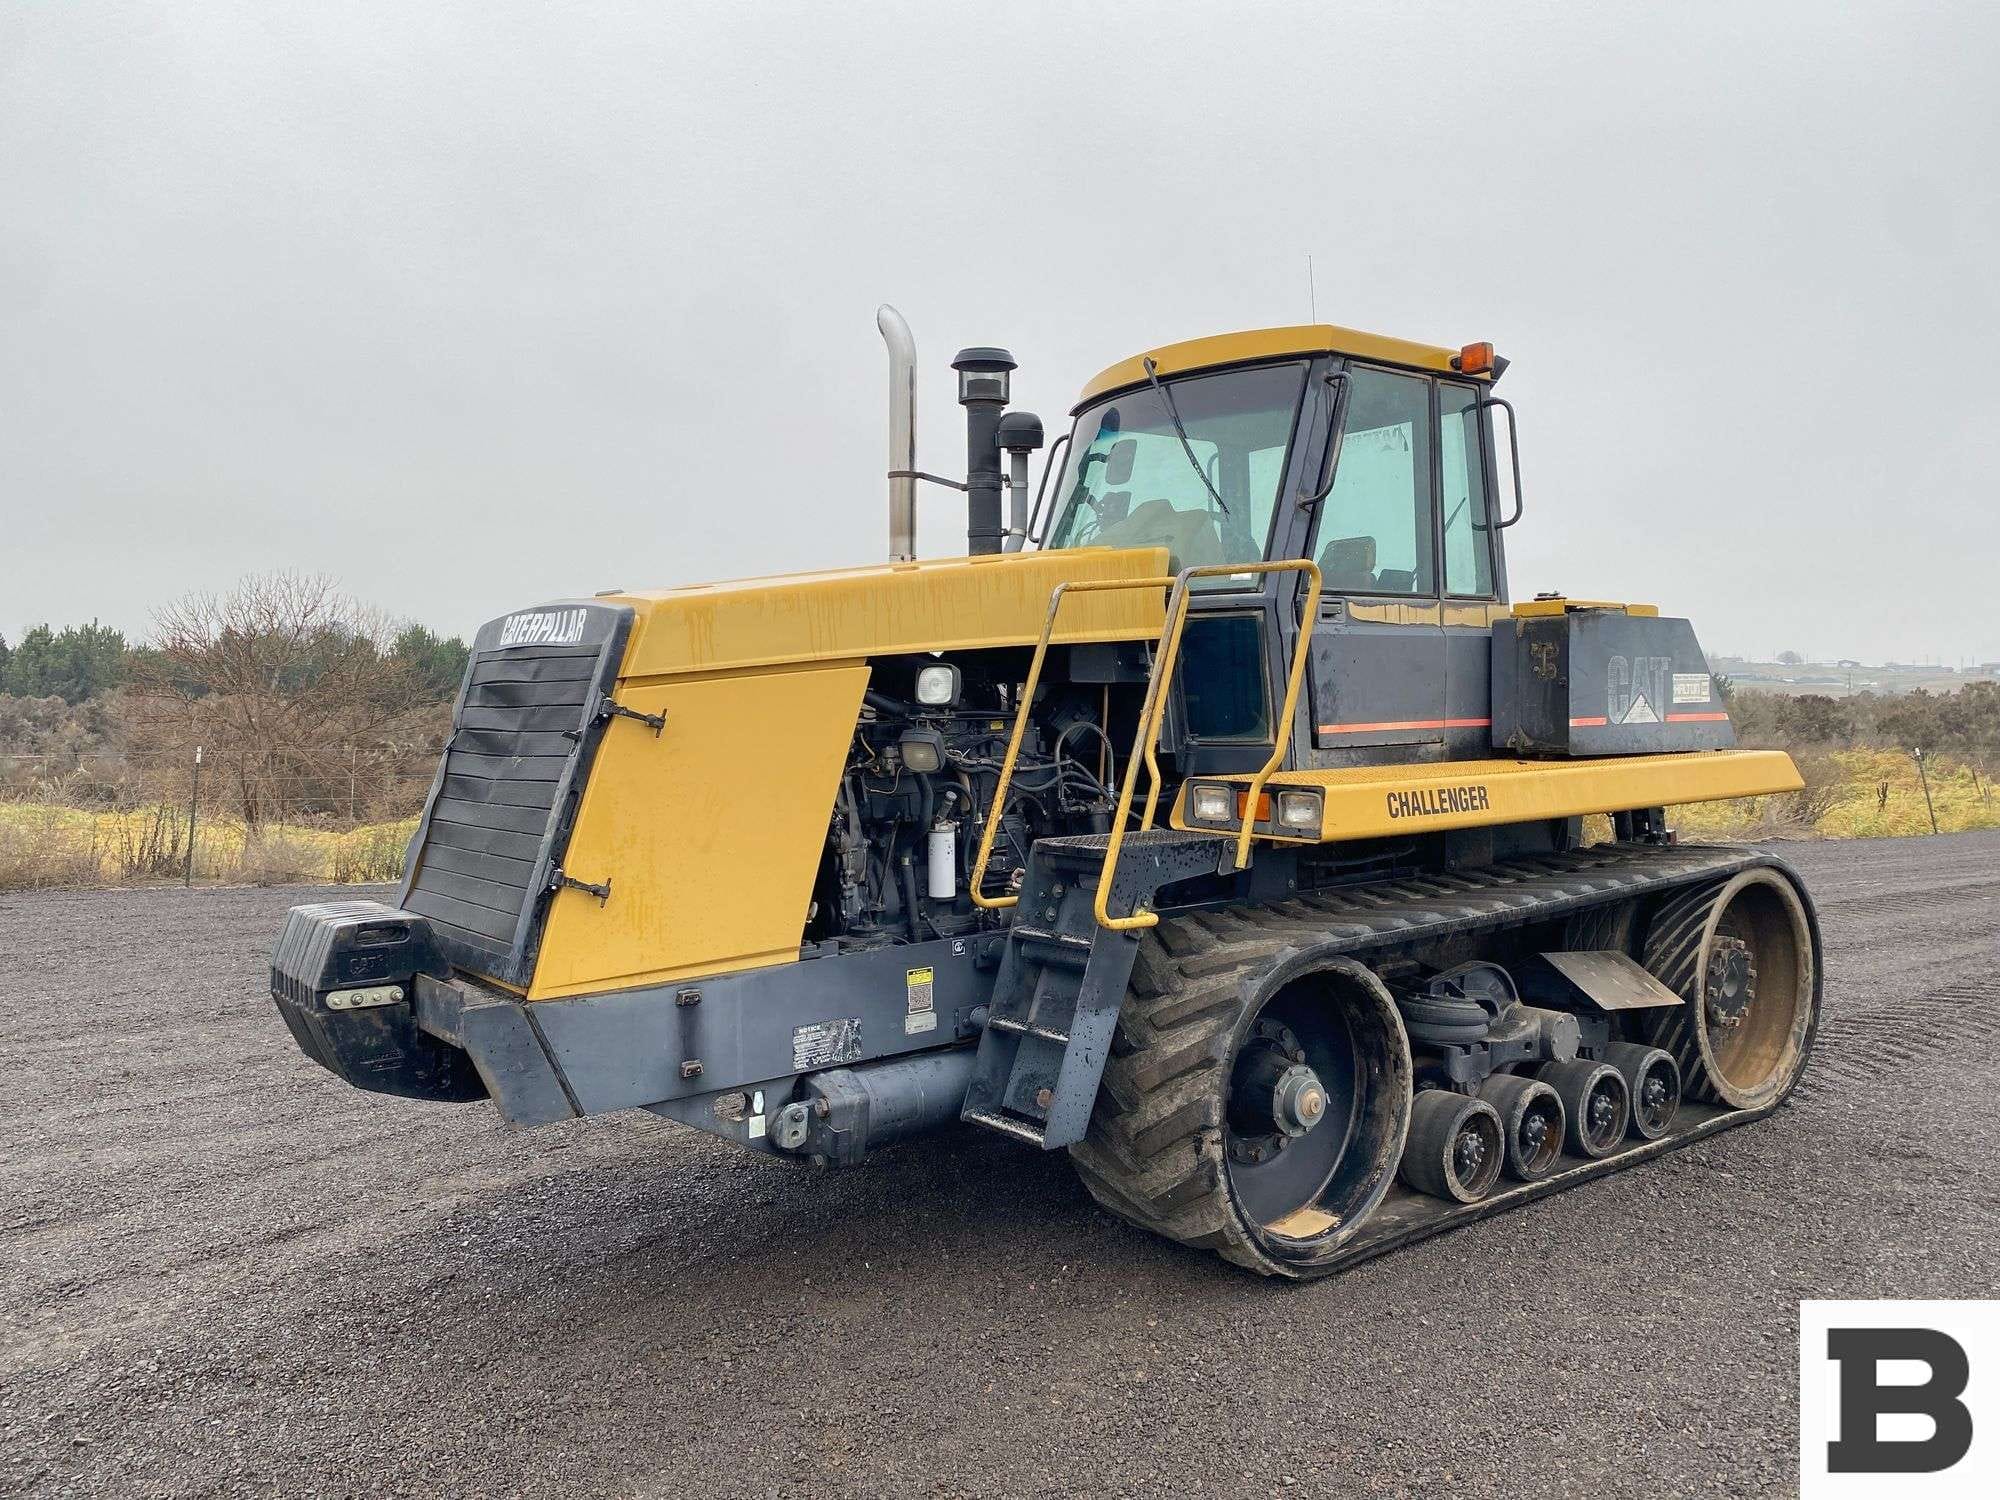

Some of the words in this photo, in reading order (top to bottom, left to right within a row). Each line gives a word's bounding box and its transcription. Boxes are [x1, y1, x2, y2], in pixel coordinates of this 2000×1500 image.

[501, 608, 587, 646] CATERPILLAR
[1607, 655, 1671, 725] CAT
[1386, 785, 1490, 819] CHALLENGER
